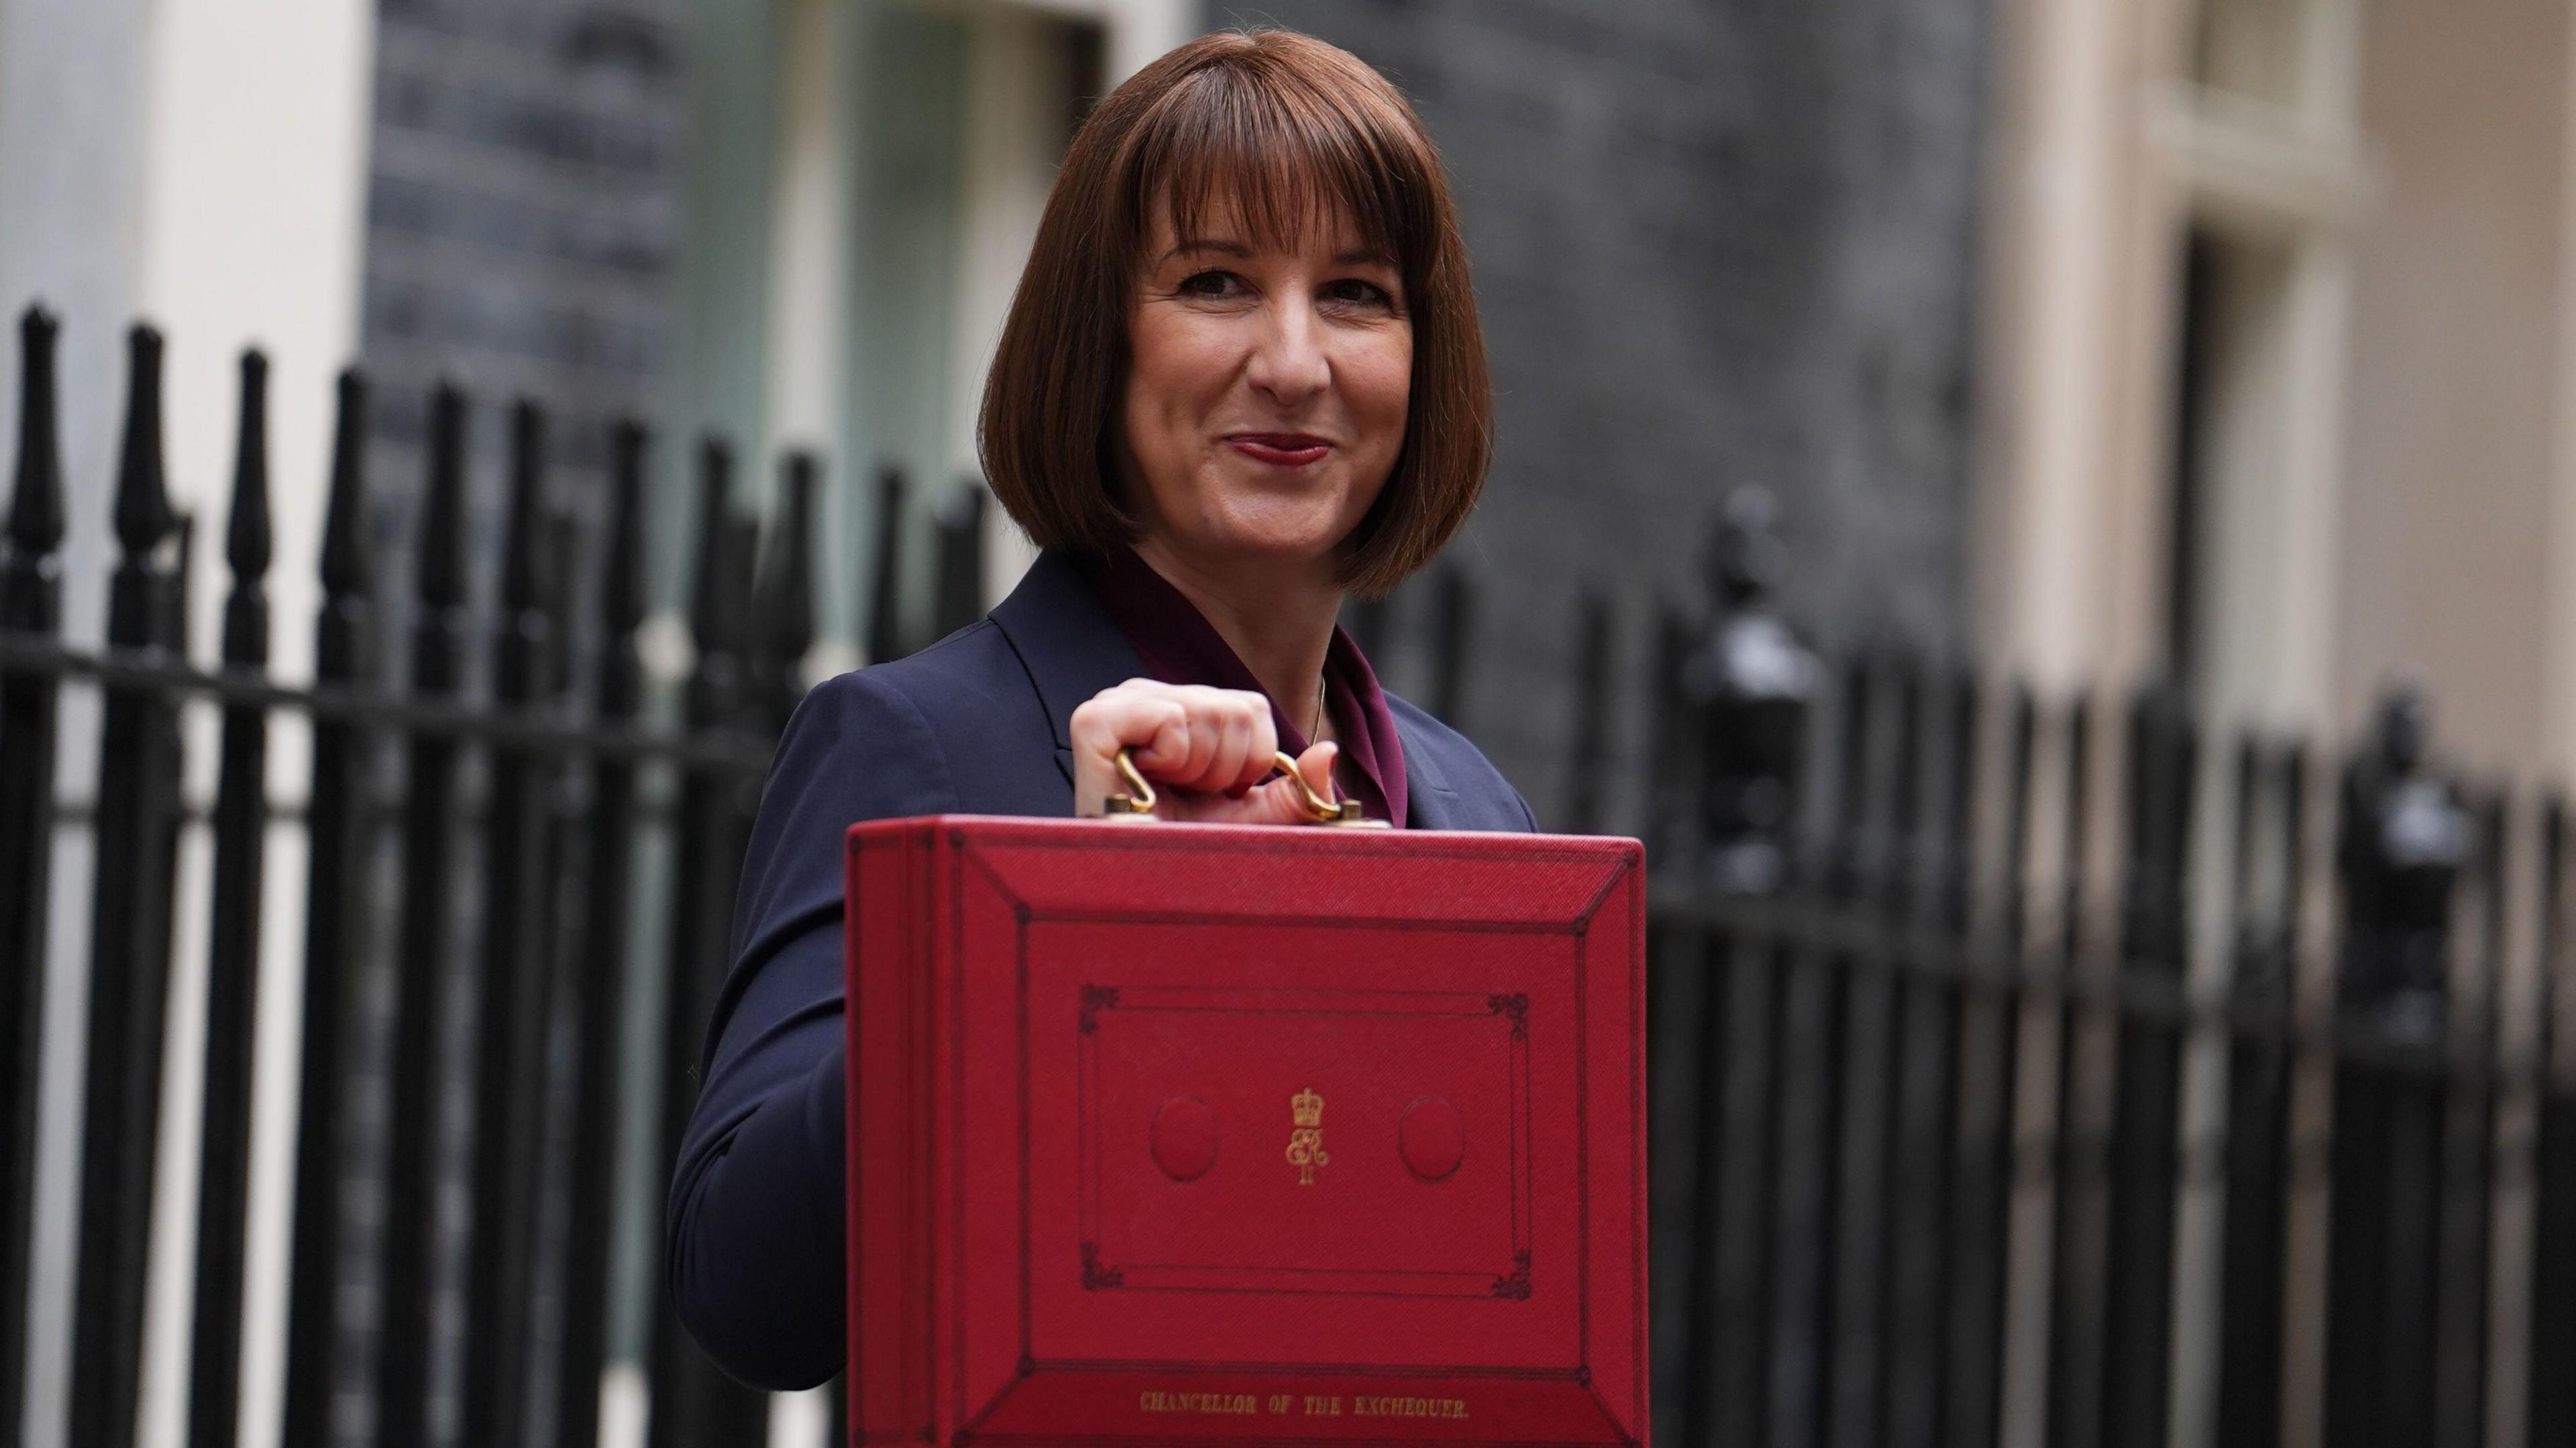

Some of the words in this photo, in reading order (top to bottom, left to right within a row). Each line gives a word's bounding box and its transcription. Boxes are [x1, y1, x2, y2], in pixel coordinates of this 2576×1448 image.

[1140, 1392, 1257, 1414] CHANCELLOR
[1268, 1394, 1293, 1414] OF
[1304, 1395, 1342, 1416] THE
[1354, 1396, 1469, 1419] EXCHEQUER.
